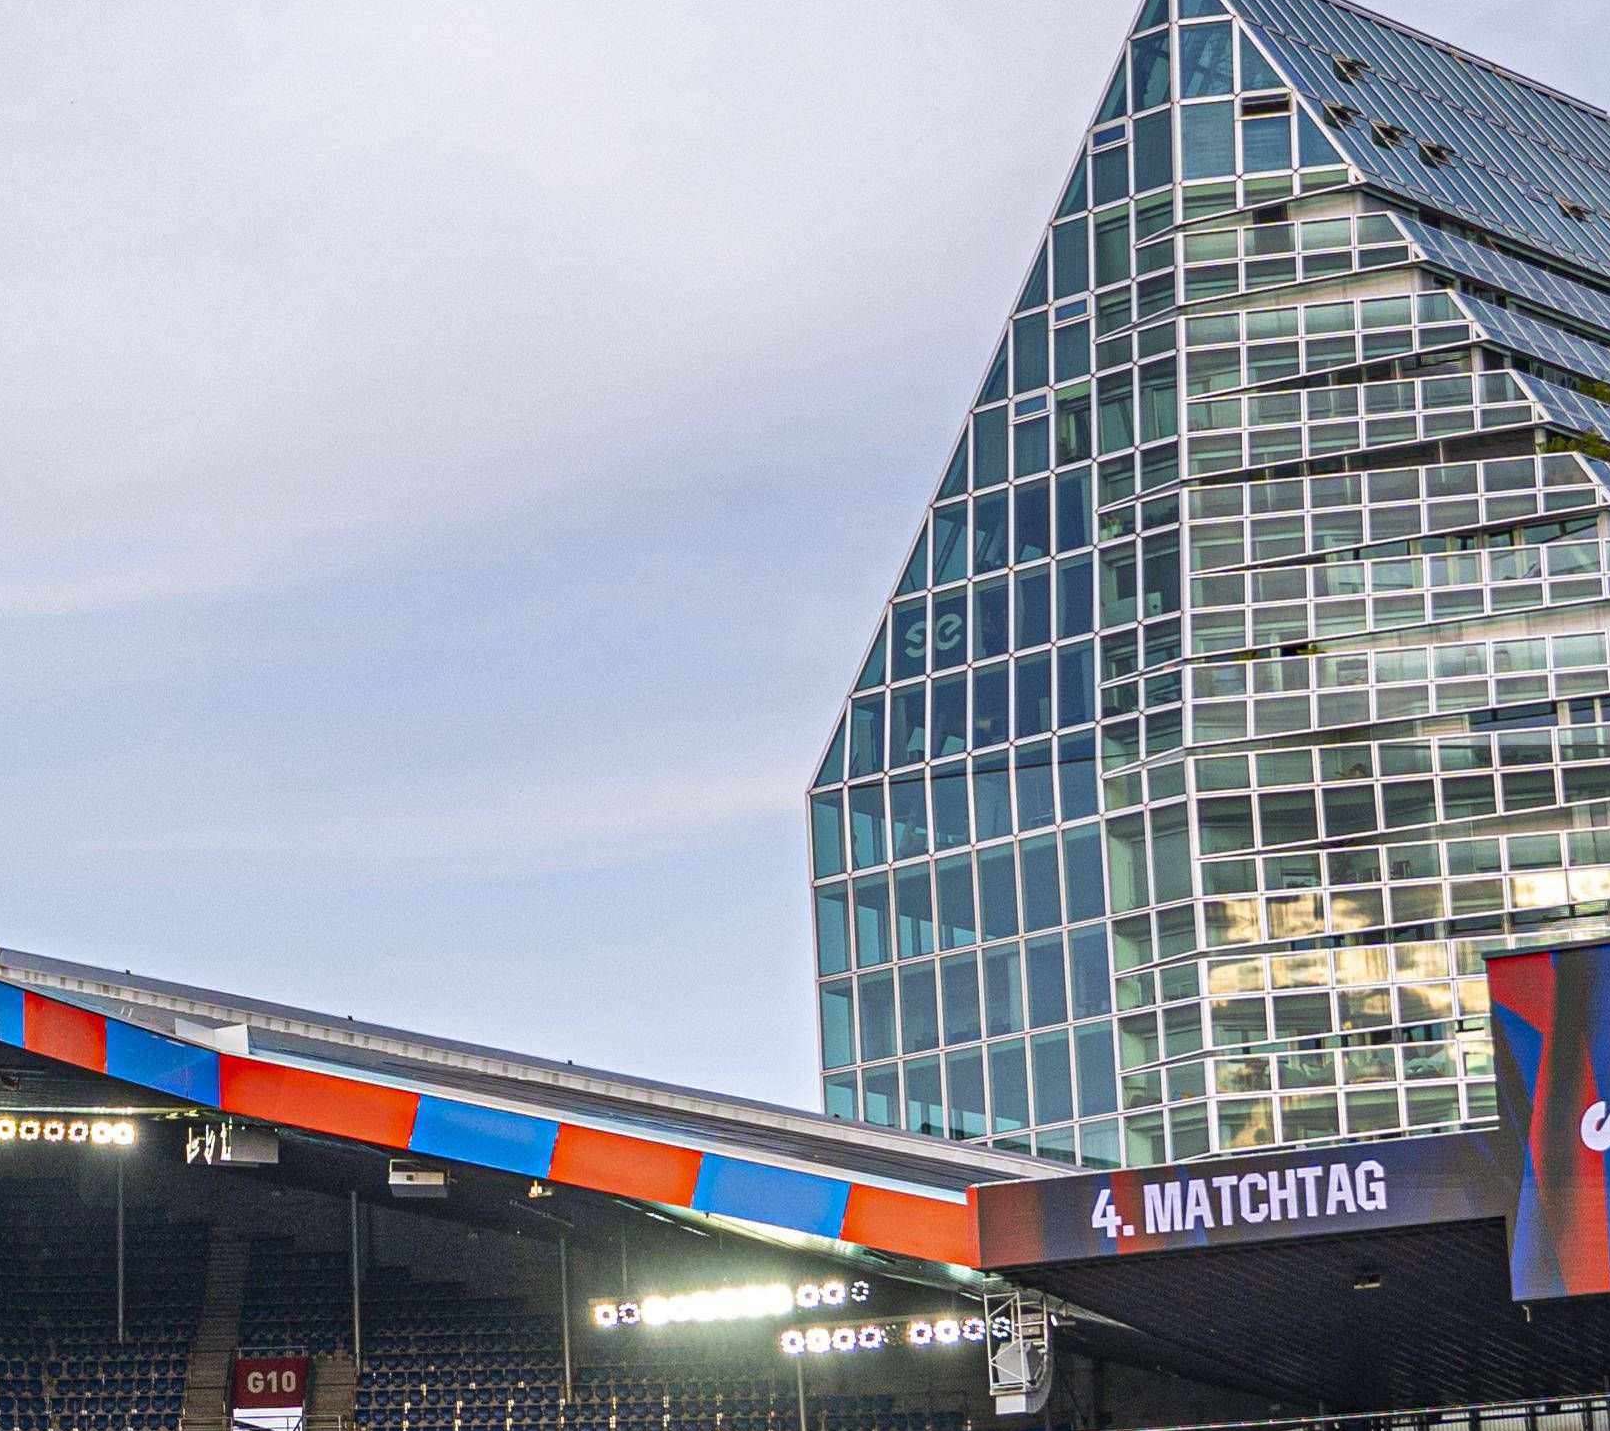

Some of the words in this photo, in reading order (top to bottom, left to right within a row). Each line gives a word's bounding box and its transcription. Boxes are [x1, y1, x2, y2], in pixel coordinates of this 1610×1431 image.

[1090, 1188, 1135, 1239] 4.
[1142, 1159, 1388, 1235] MATCHTAG
[247, 1370, 297, 1394] G10
